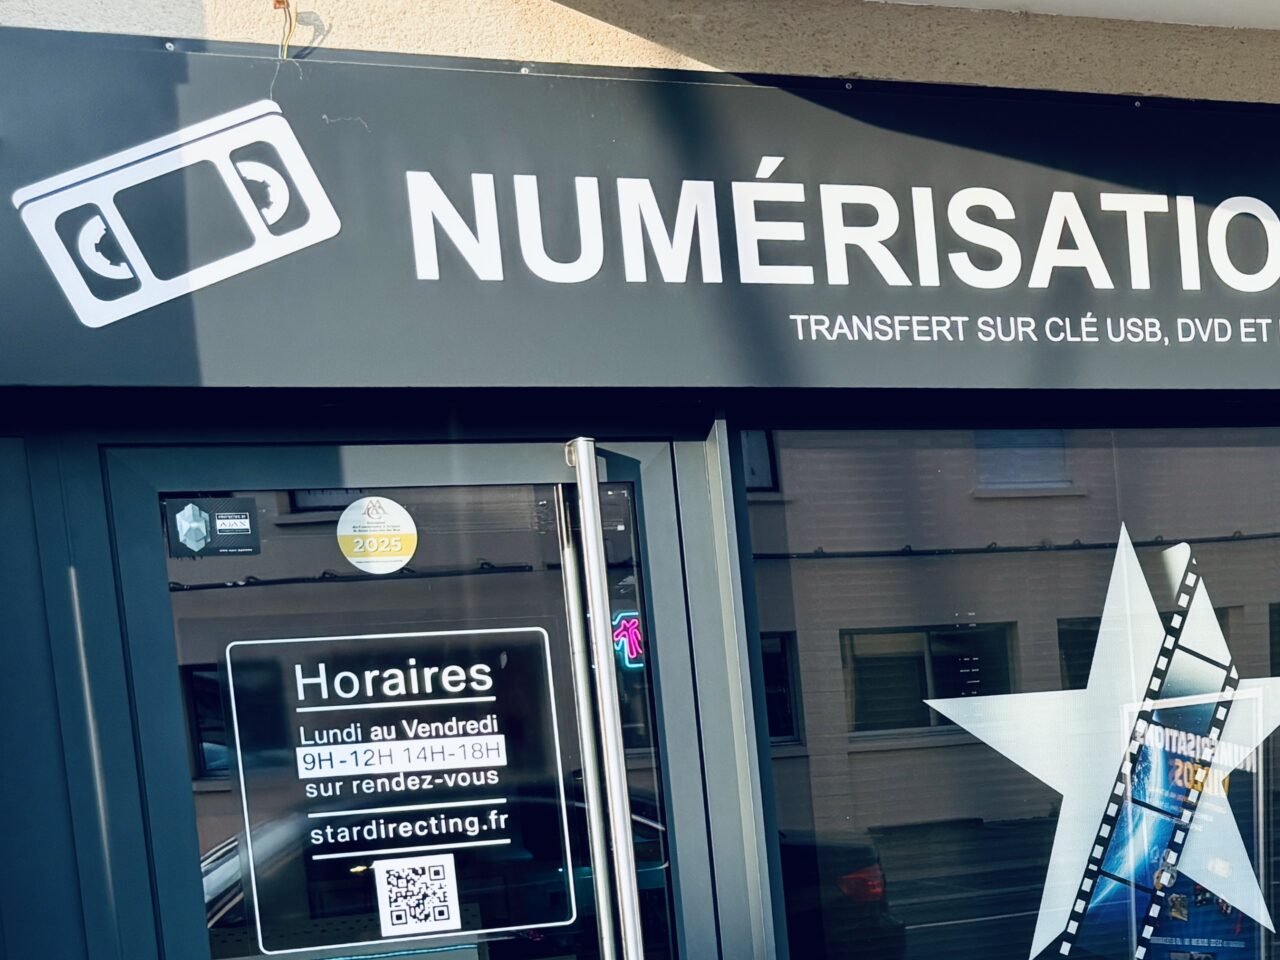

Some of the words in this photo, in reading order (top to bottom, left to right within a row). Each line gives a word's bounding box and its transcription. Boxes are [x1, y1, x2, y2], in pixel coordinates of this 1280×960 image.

[789, 314, 969, 342] TRANSFERT
[977, 315, 1038, 343] SUR
[1045, 312, 1099, 343] CLÉ
[1107, 317, 1169, 346] USB,
[1177, 318, 1232, 343] DVD
[1240, 318, 1273, 344] ET
[353, 537, 402, 553] 2025
[294, 658, 493, 700] Horaires
[299, 722, 362, 746] Lundi
[370, 725, 397, 742] au
[402, 714, 499, 739] Vendredi
[403, 741, 501, 764] 14H-18H
[305, 779, 343, 798] sur
[352, 767, 500, 795] rendez-vous
[310, 811, 509, 845] stardirecting.fr
